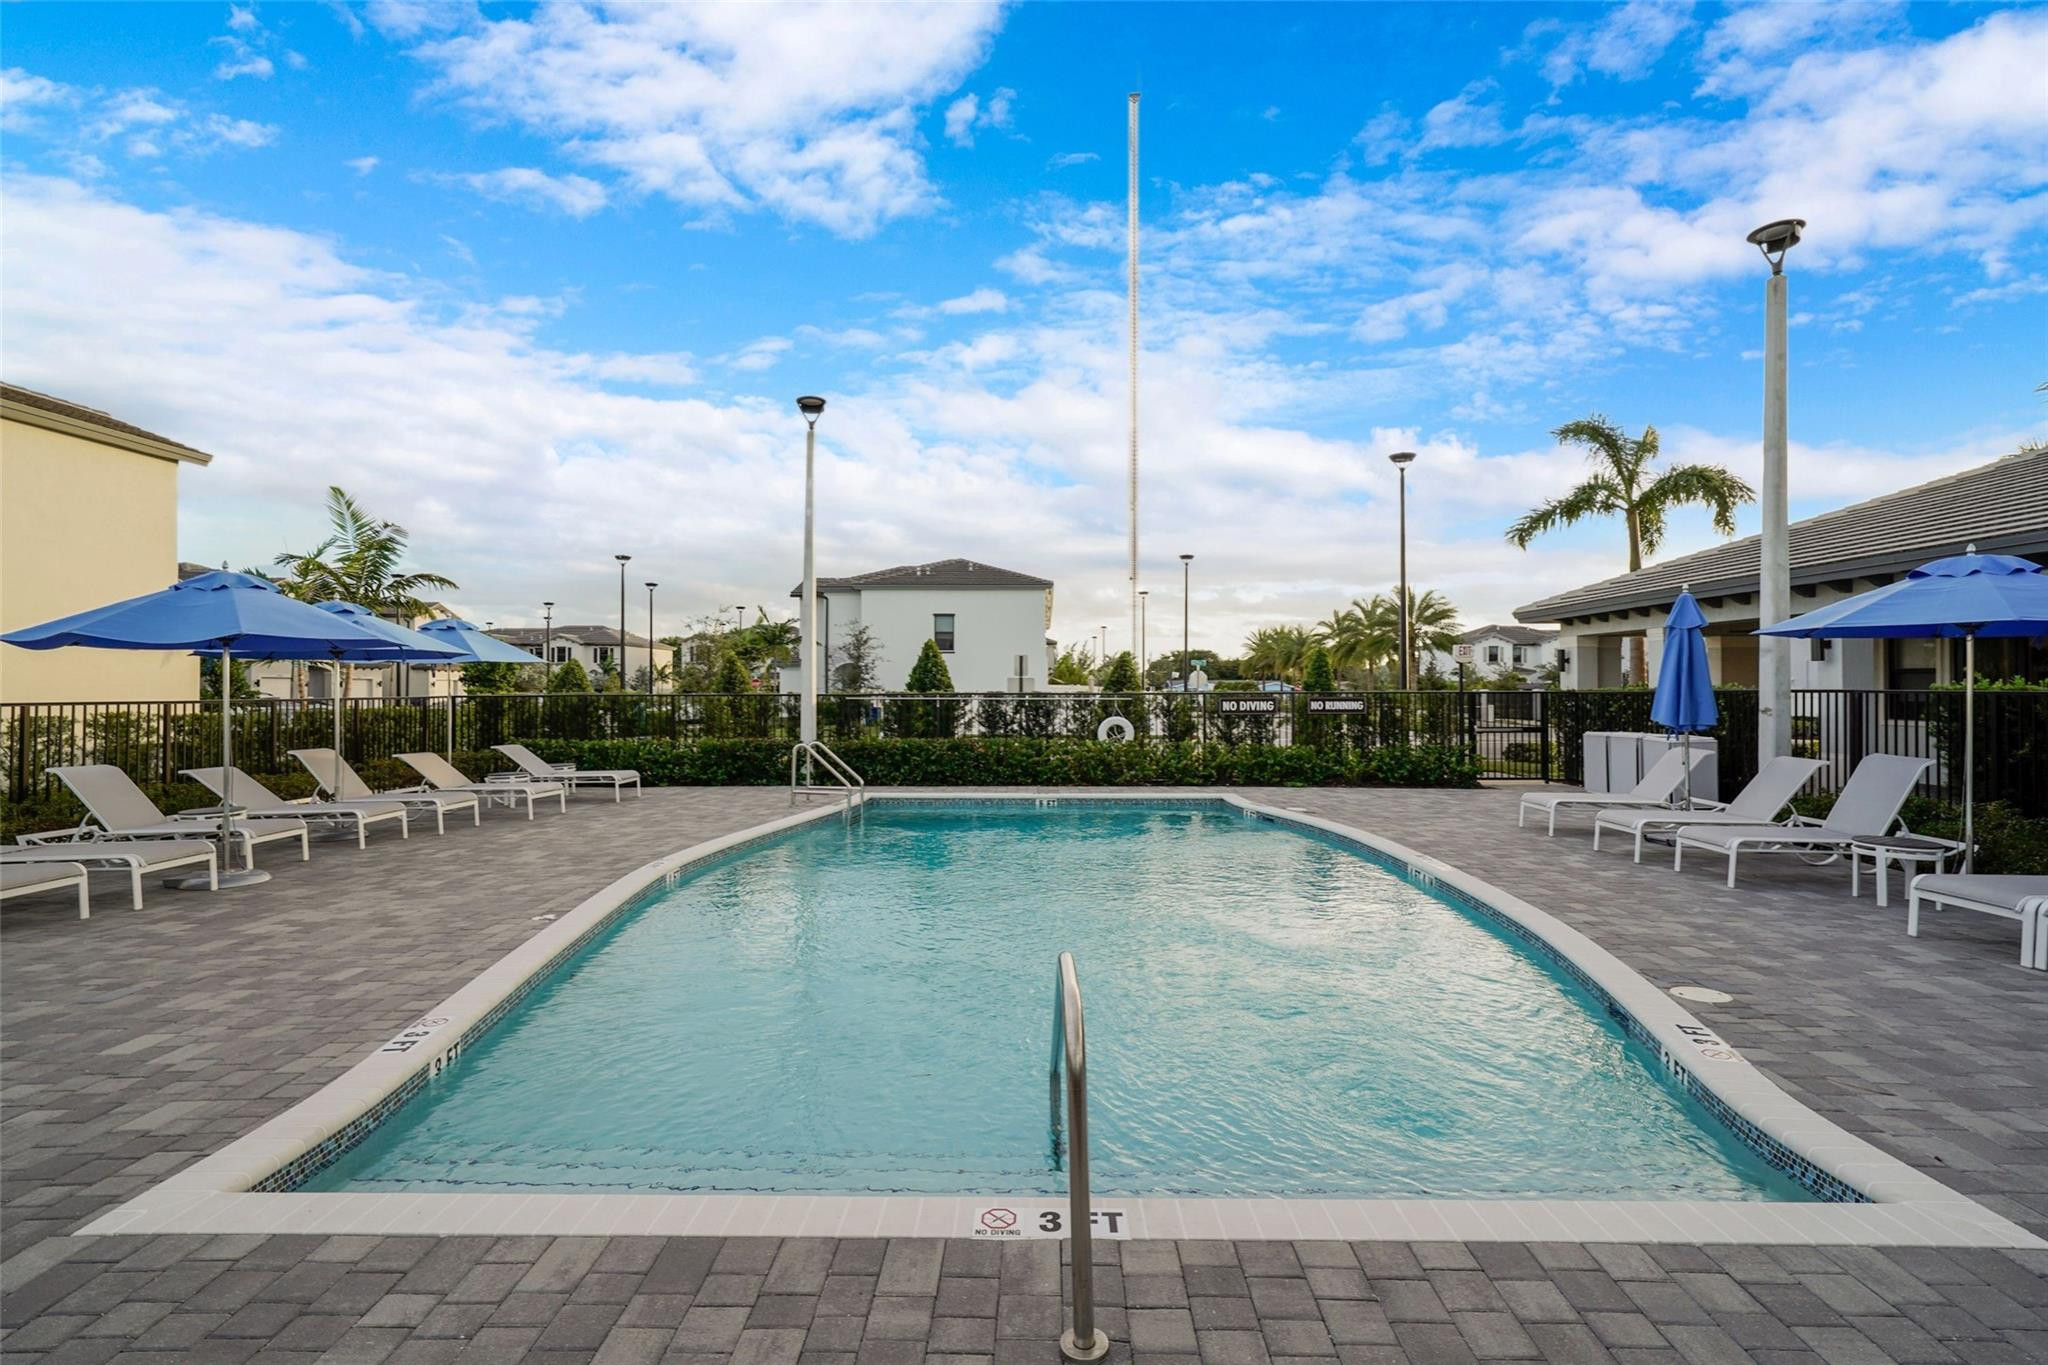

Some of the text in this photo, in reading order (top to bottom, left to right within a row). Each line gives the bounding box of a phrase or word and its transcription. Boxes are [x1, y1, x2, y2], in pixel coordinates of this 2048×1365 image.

[1222, 700, 1275, 711] NO DIVING
[1310, 700, 1364, 710] NO RUNNING
[1675, 1023, 1711, 1037] FT
[381, 1040, 419, 1053] FT
[446, 1041, 460, 1068] FT
[1039, 1211, 1062, 1233] 3
